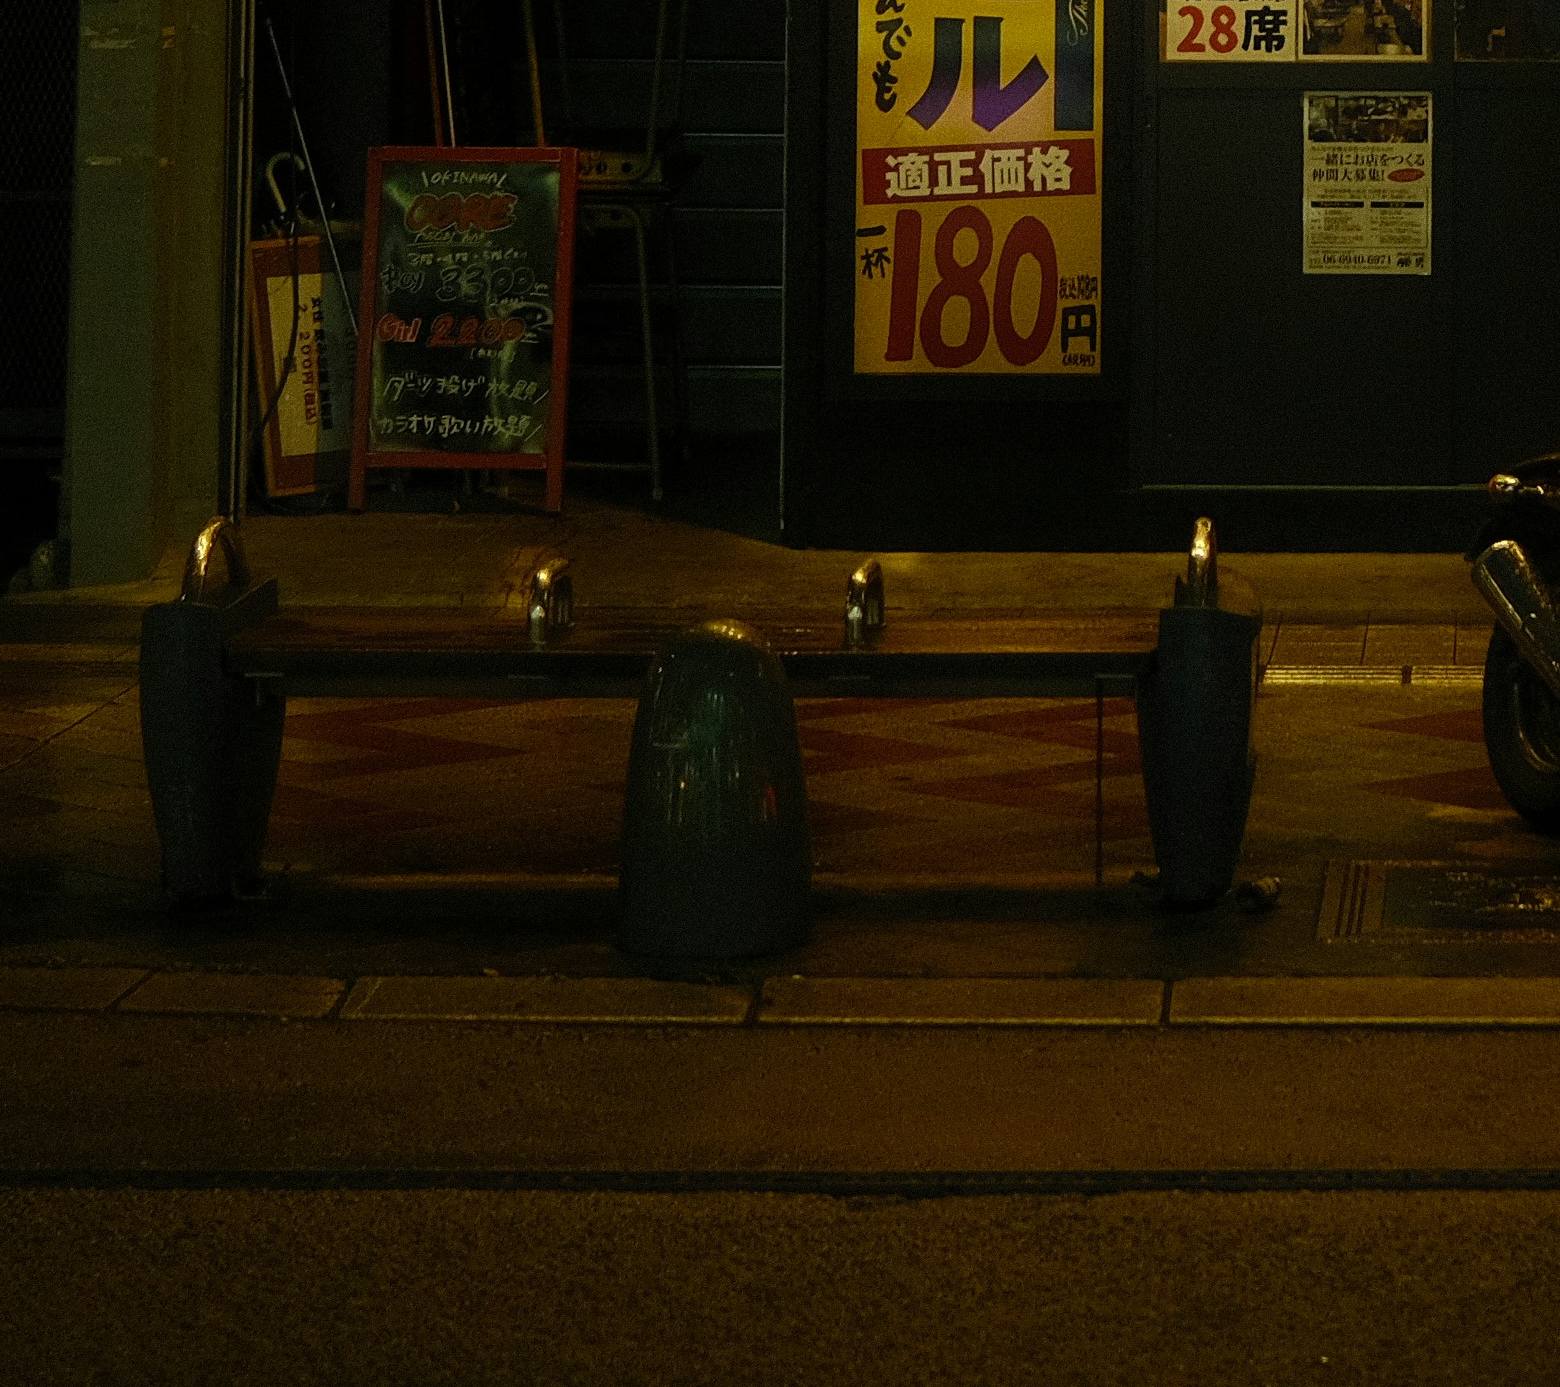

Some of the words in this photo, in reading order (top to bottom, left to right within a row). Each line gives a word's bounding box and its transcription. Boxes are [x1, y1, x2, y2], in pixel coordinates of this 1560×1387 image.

[1176, 5, 1288, 55] 28席
[883, 145, 1074, 201] 適正価格
[855, 224, 892, 280] 一杯
[884, 204, 1059, 369] 180
[1060, 303, 1098, 354] 円
